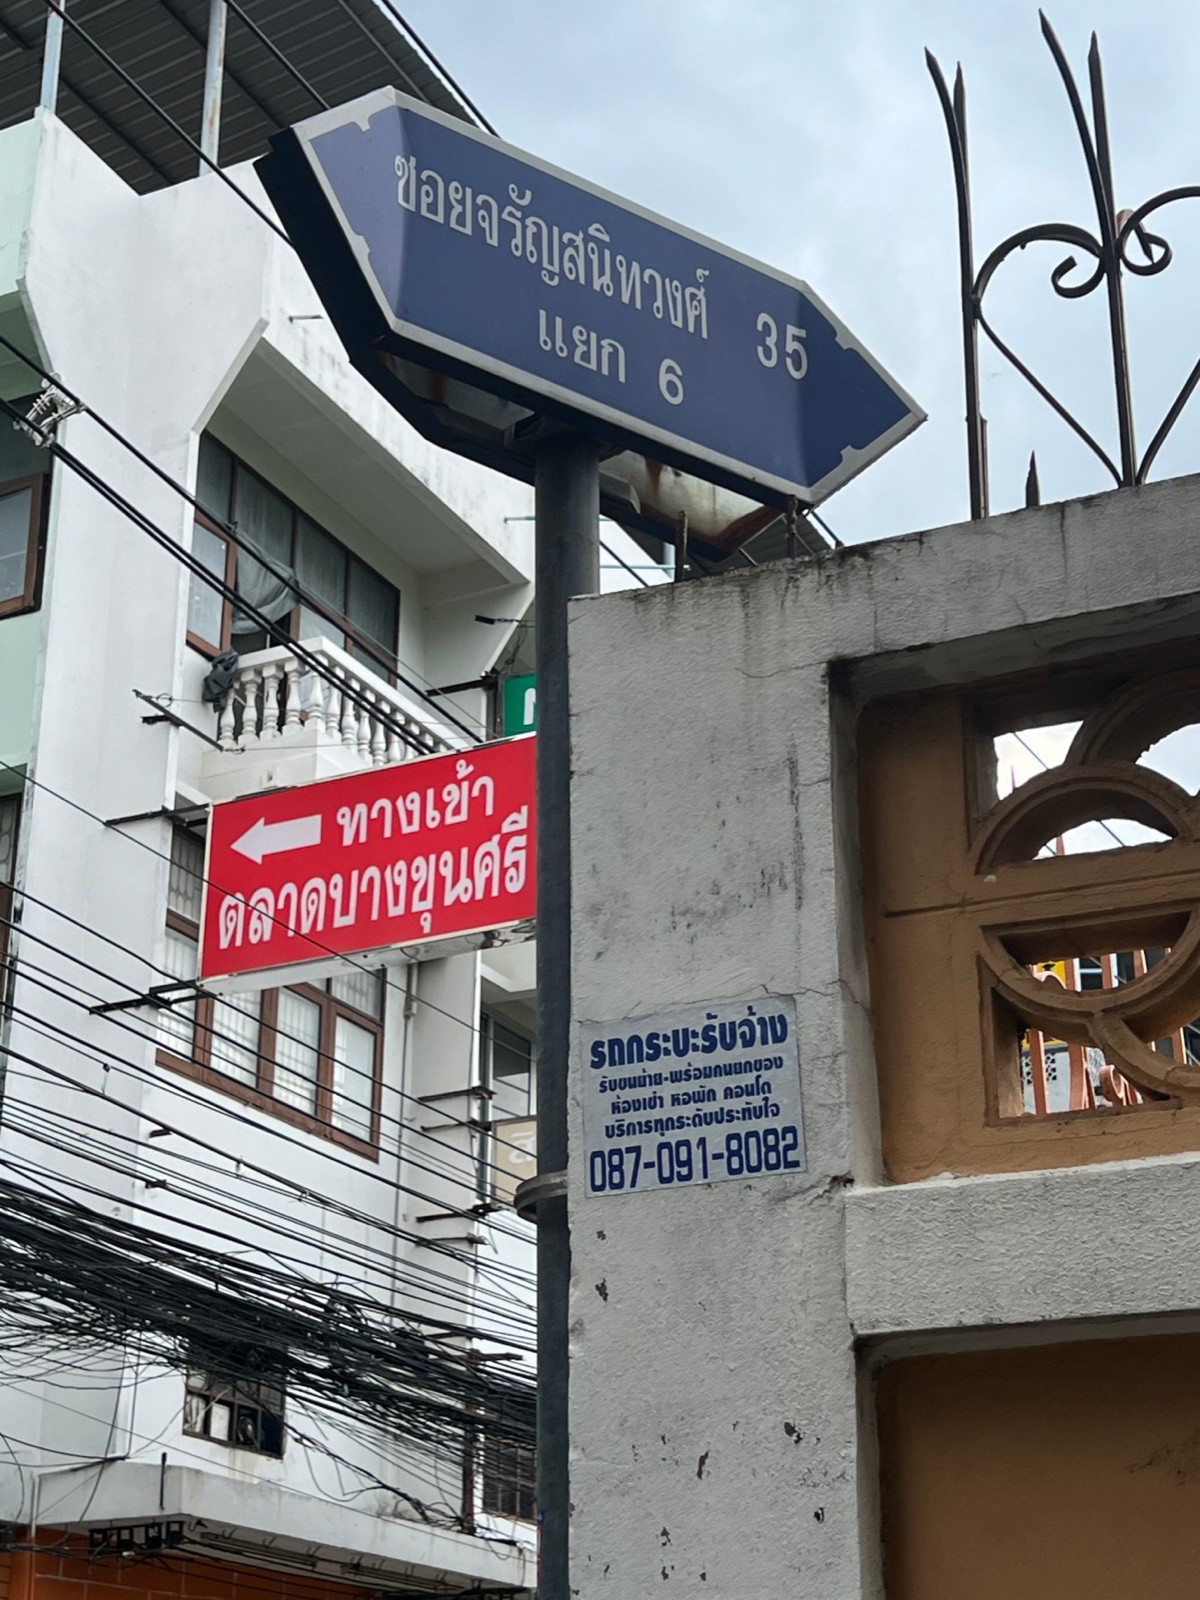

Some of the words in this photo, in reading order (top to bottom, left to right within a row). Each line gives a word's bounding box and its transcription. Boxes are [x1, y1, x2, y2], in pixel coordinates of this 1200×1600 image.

[394, 154, 710, 340] ซอยจรัญสนิทวงศ์
[755, 312, 808, 381] 35
[538, 308, 627, 383] แยก
[658, 357, 684, 406] 6
[336, 759, 495, 847] ทางเข้า
[218, 805, 529, 950] ตลาดบางขุนศรี
[590, 1005, 788, 1070] รถกระบะรับจ้าง
[611, 1091, 664, 1115] ห้องเช่า
[671, 1085, 717, 1107] หอพัก
[723, 1074, 772, 1100] คอนโด
[589, 1125, 801, 1193] 087-091-8082
